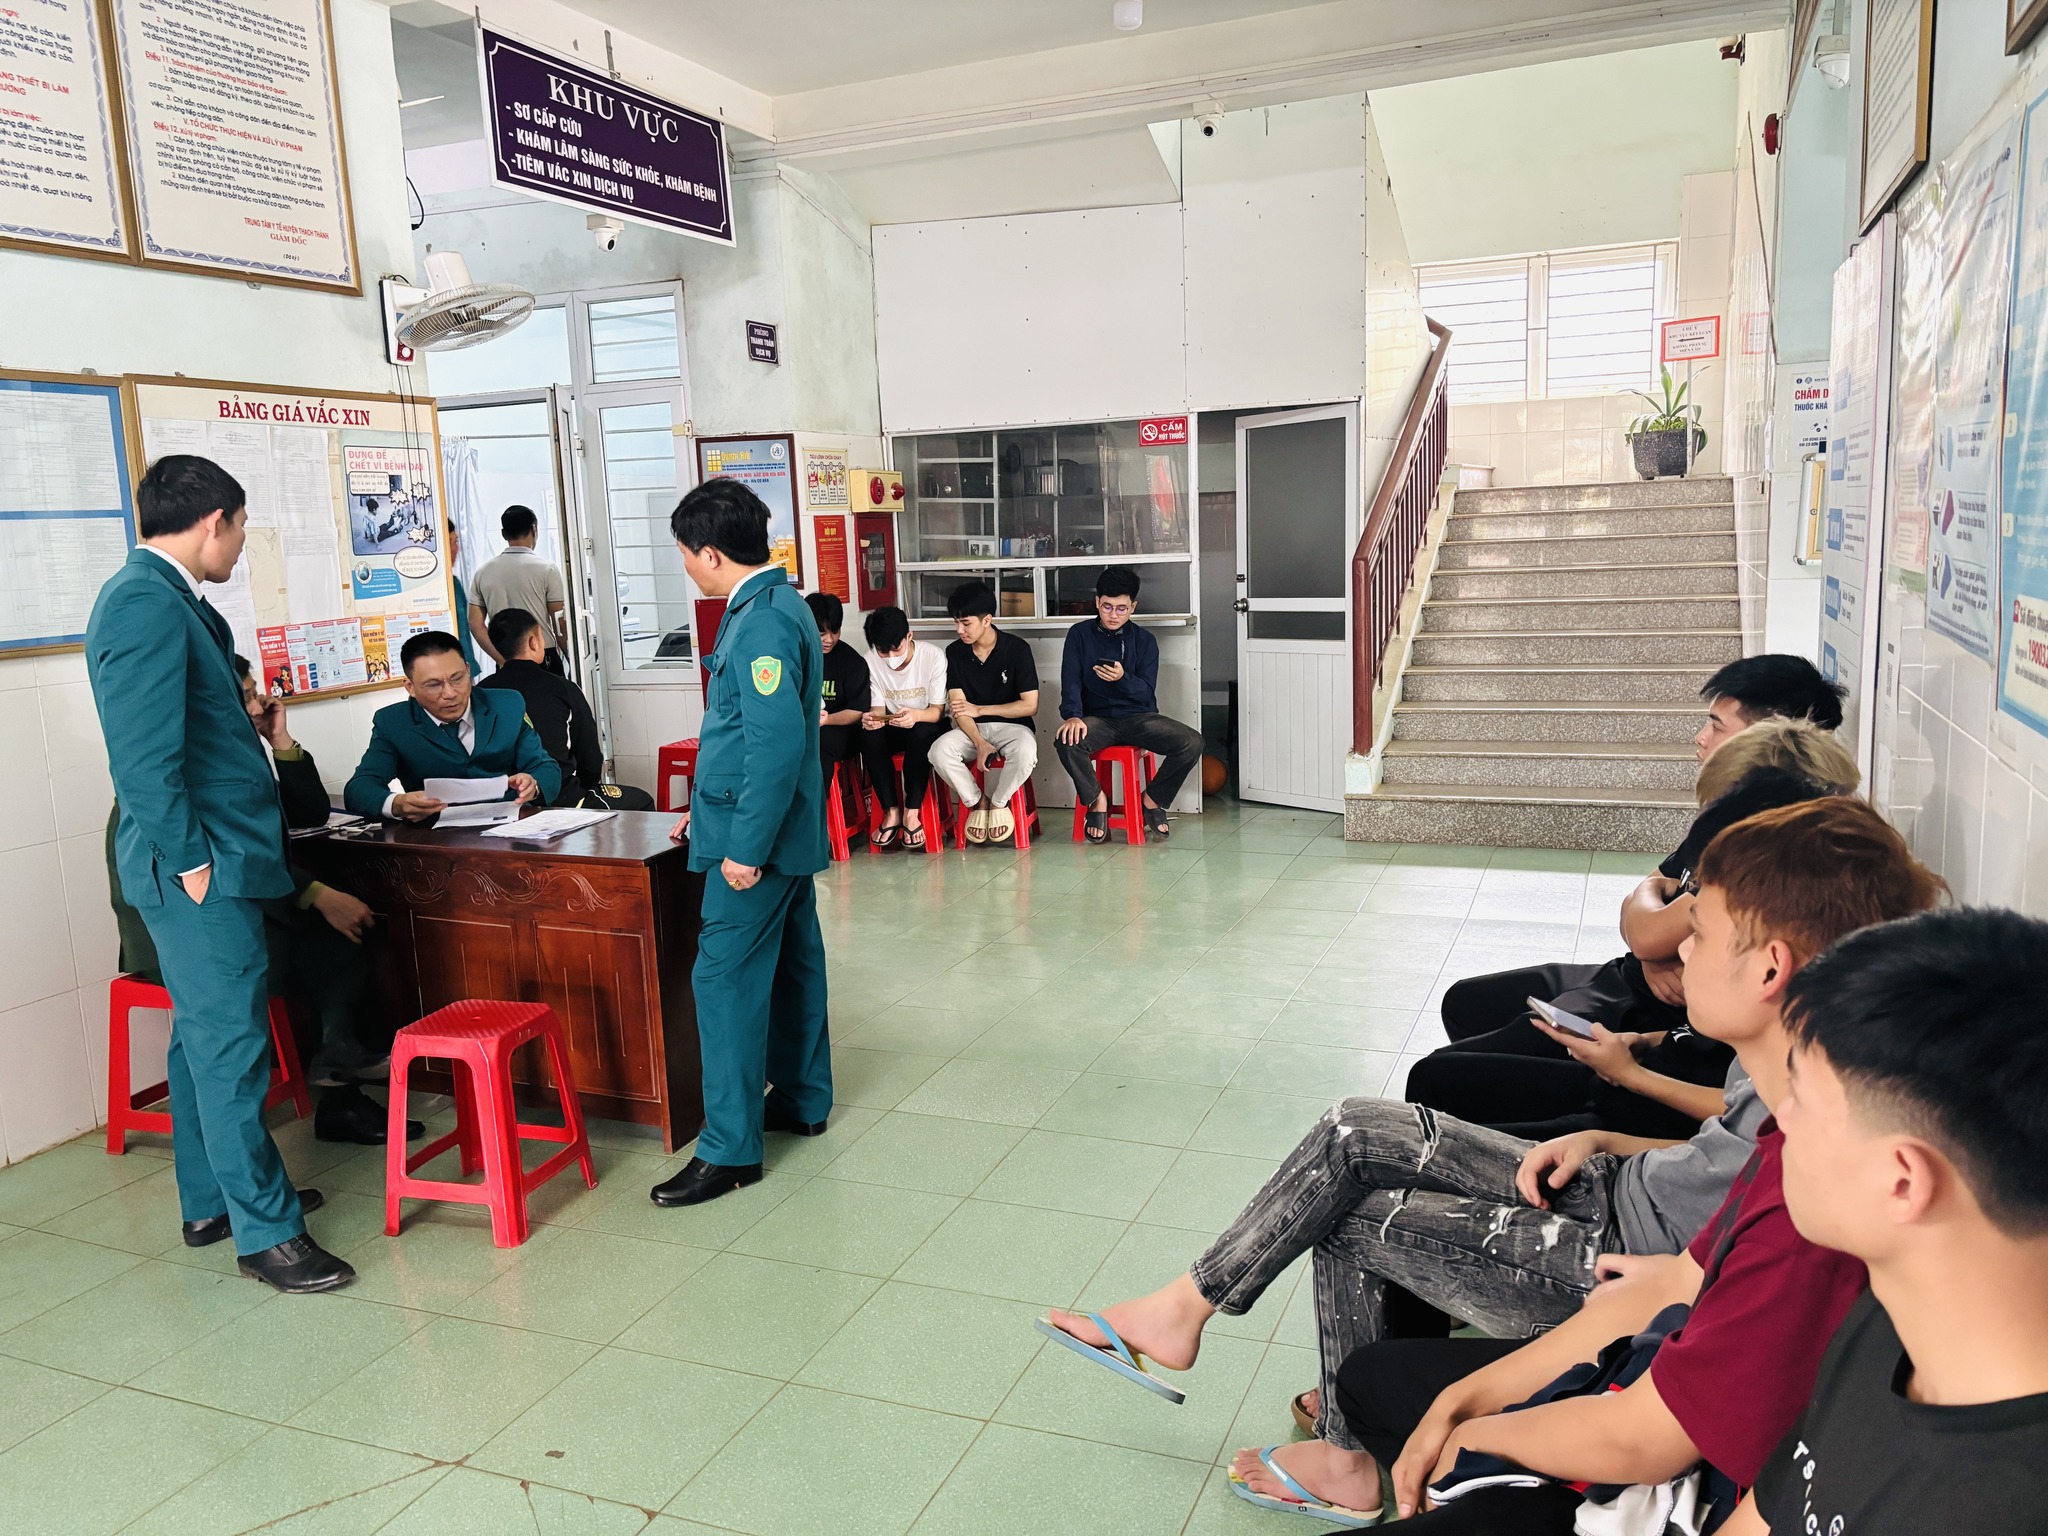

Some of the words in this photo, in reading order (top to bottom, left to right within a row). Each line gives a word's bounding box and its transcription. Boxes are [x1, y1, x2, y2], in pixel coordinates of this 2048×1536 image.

[15, 74, 39, 86] THIẾT
[41, 80, 50, 91] BỊ
[51, 83, 69, 94] LÀM
[546, 73, 615, 120] KHU
[621, 100, 679, 143] VỰC
[514, 101, 532, 119] SƠ
[534, 105, 557, 128] CẤP
[560, 115, 583, 138] CỨU
[516, 128, 552, 153] KHÁM
[555, 139, 578, 162] LÂM
[581, 149, 610, 171] SÀNG
[612, 157, 633, 178] SỨC
[635, 165, 664, 189] KHỎE,
[665, 174, 692, 196] KHÁM
[694, 181, 718, 203] BỆNH
[547, 161, 570, 183] VÁC
[572, 169, 591, 190] XIN
[594, 175, 619, 198] DỊCH
[621, 184, 635, 204] VỤ
[269, 232, 290, 242] GIÁM
[291, 235, 307, 245] ĐỐC
[1794, 385, 1820, 400] CHẤM
[218, 394, 269, 420] BẢNG
[272, 399, 303, 422] GIÁ
[305, 399, 340, 424] VẮC
[342, 409, 371, 427] XIN
[1794, 400, 1814, 412] THUỐC
[1160, 420, 1183, 432] CẤM
[1158, 432, 1168, 441] HÚT
[1169, 430, 1185, 440] THUỐC
[348, 448, 374, 460] ĐỪNG
[376, 449, 387, 460] ĐỂ
[349, 459, 371, 471] CHẾT
[373, 460, 383, 471] VÌ
[384, 460, 407, 472] BỆNH
